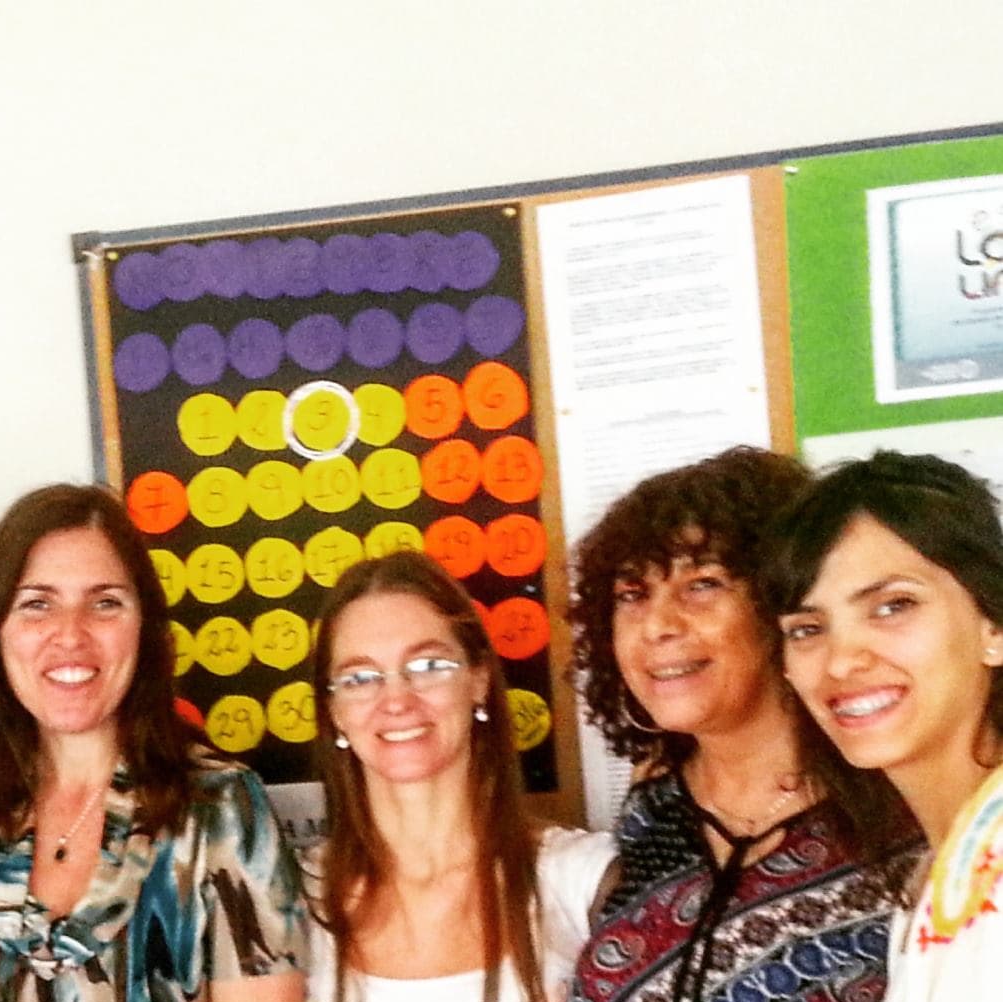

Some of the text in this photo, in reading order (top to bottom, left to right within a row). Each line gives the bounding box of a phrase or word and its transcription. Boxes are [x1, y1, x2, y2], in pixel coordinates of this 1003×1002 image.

[197, 376, 504, 441] 1 2 3 4 5 6
[143, 449, 532, 523] 7 8 9 10 11 12 13
[199, 559, 237, 591] 15
[253, 552, 293, 583] 16
[311, 544, 350, 578] 17
[441, 531, 470, 561] 19
[207, 627, 240, 657] 22
[260, 619, 300, 652] 23
[217, 694, 313, 738] 29 30
